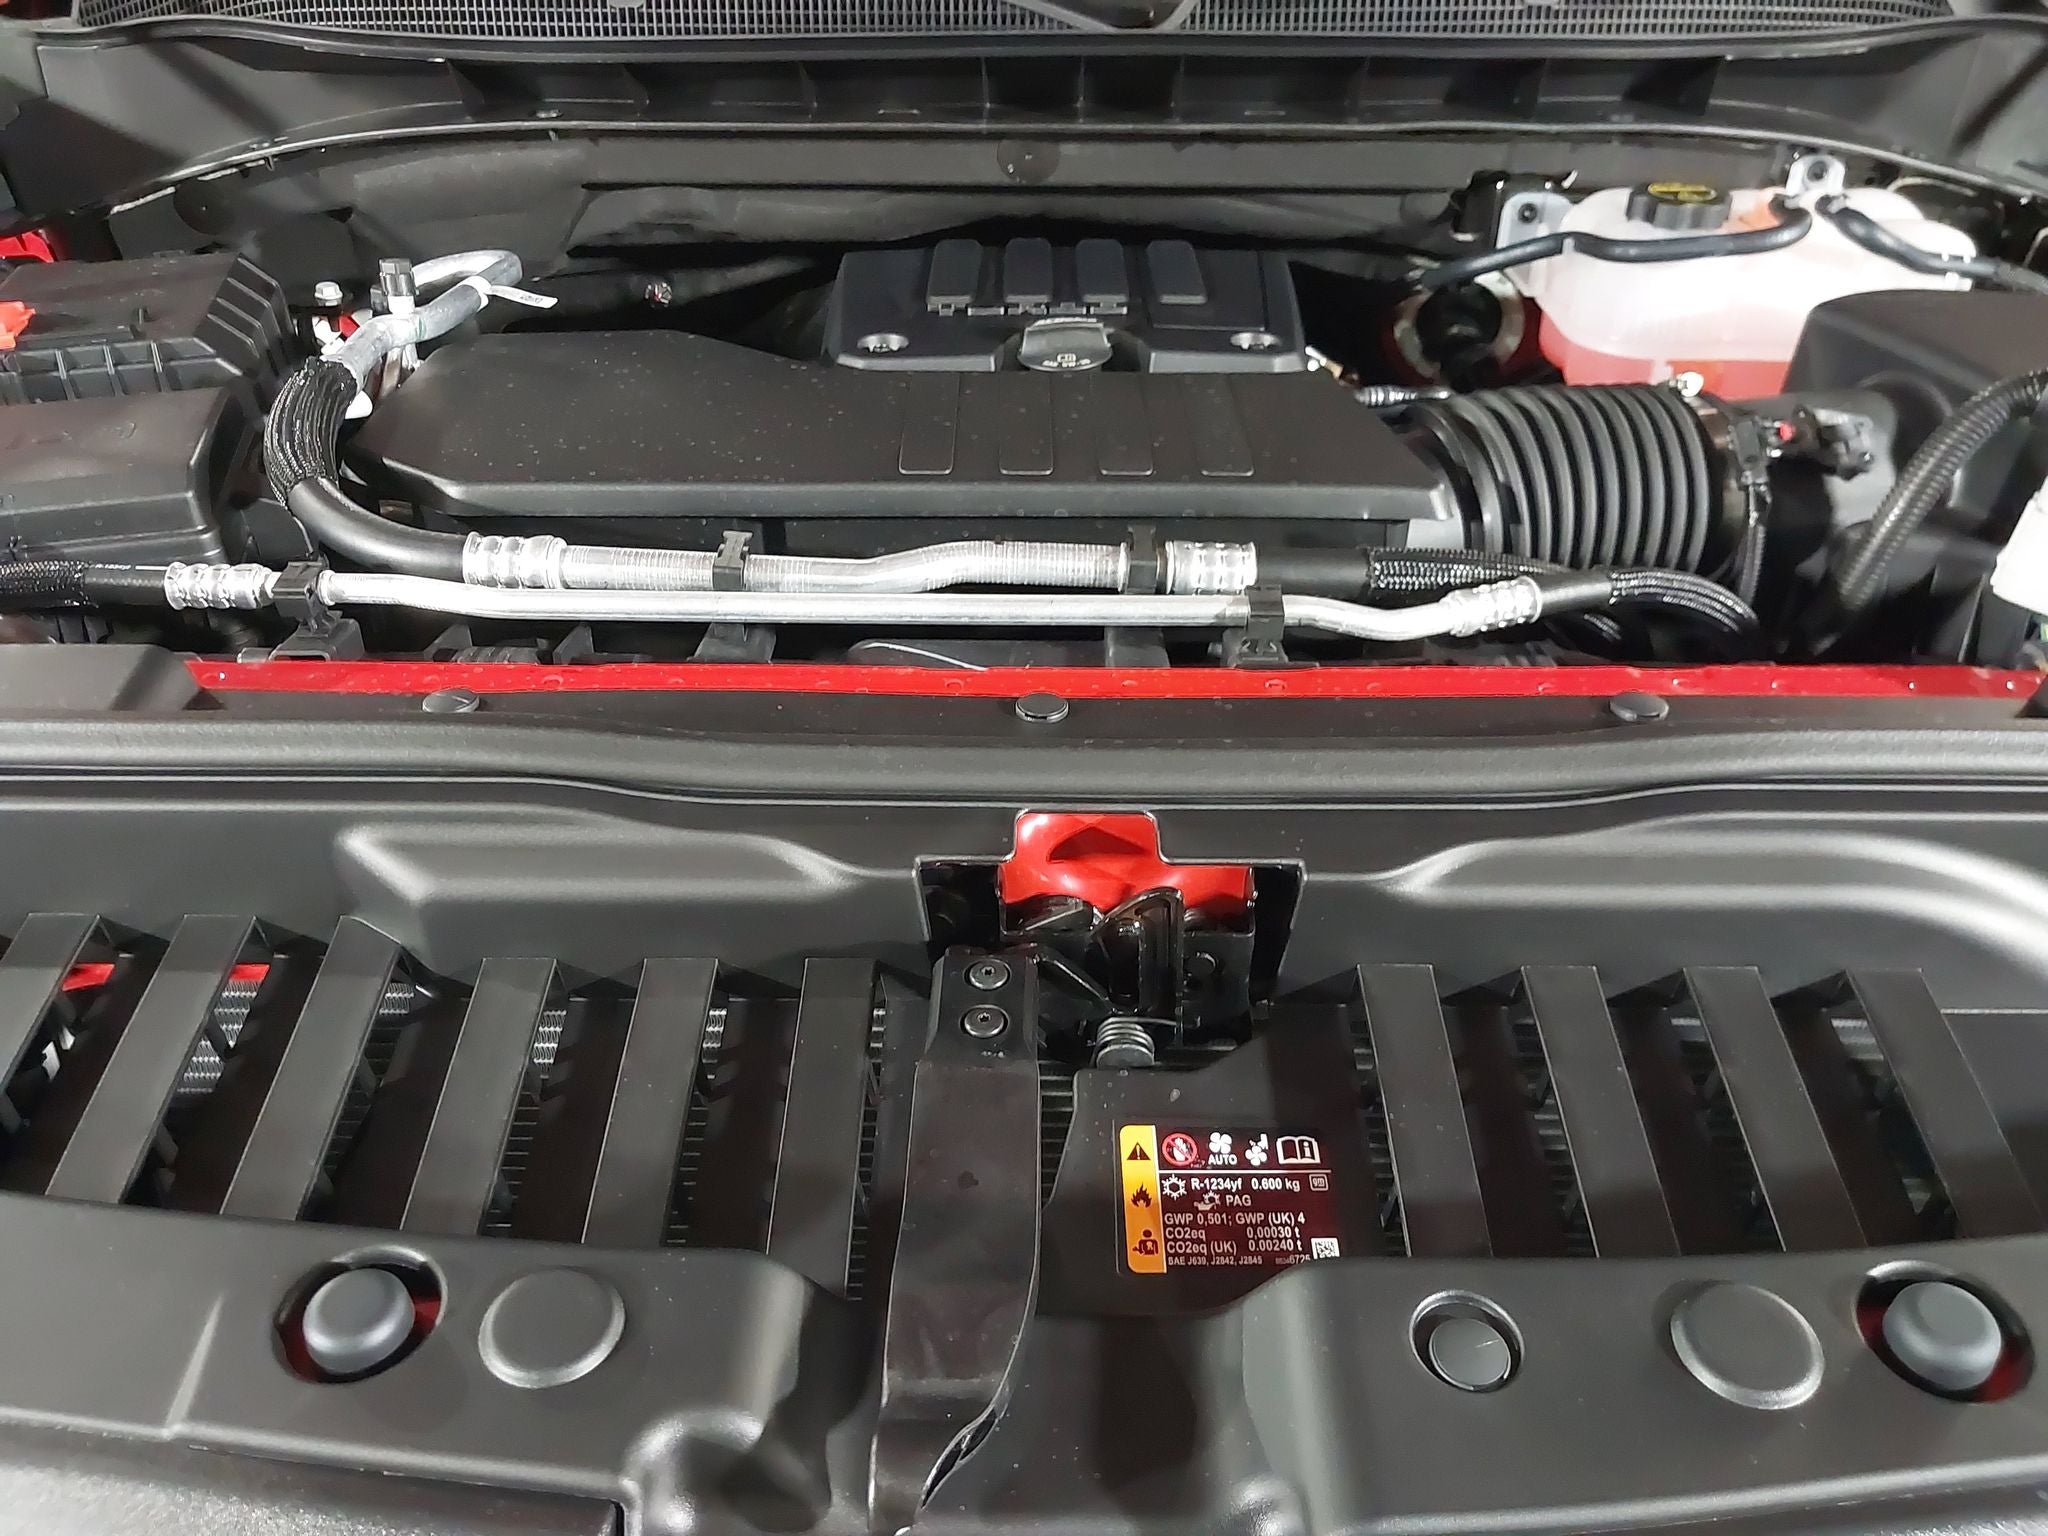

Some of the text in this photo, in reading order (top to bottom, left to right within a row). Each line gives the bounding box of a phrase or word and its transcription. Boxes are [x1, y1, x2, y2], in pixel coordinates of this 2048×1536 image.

[1207, 1154, 1238, 1166] AUTO
[1191, 1177, 1301, 1192] R-1234yf 0.600 kg
[1225, 1194, 1252, 1206] PAG
[1164, 1211, 1305, 1227] GWP 0,501; GWP (UK) 4
[1165, 1227, 1206, 1241] CO2eq
[1295, 1226, 1300, 1239] t
[1167, 1240, 1237, 1256] CO2eq (UK)
[1248, 1240, 1303, 1252] 0.00240 t
